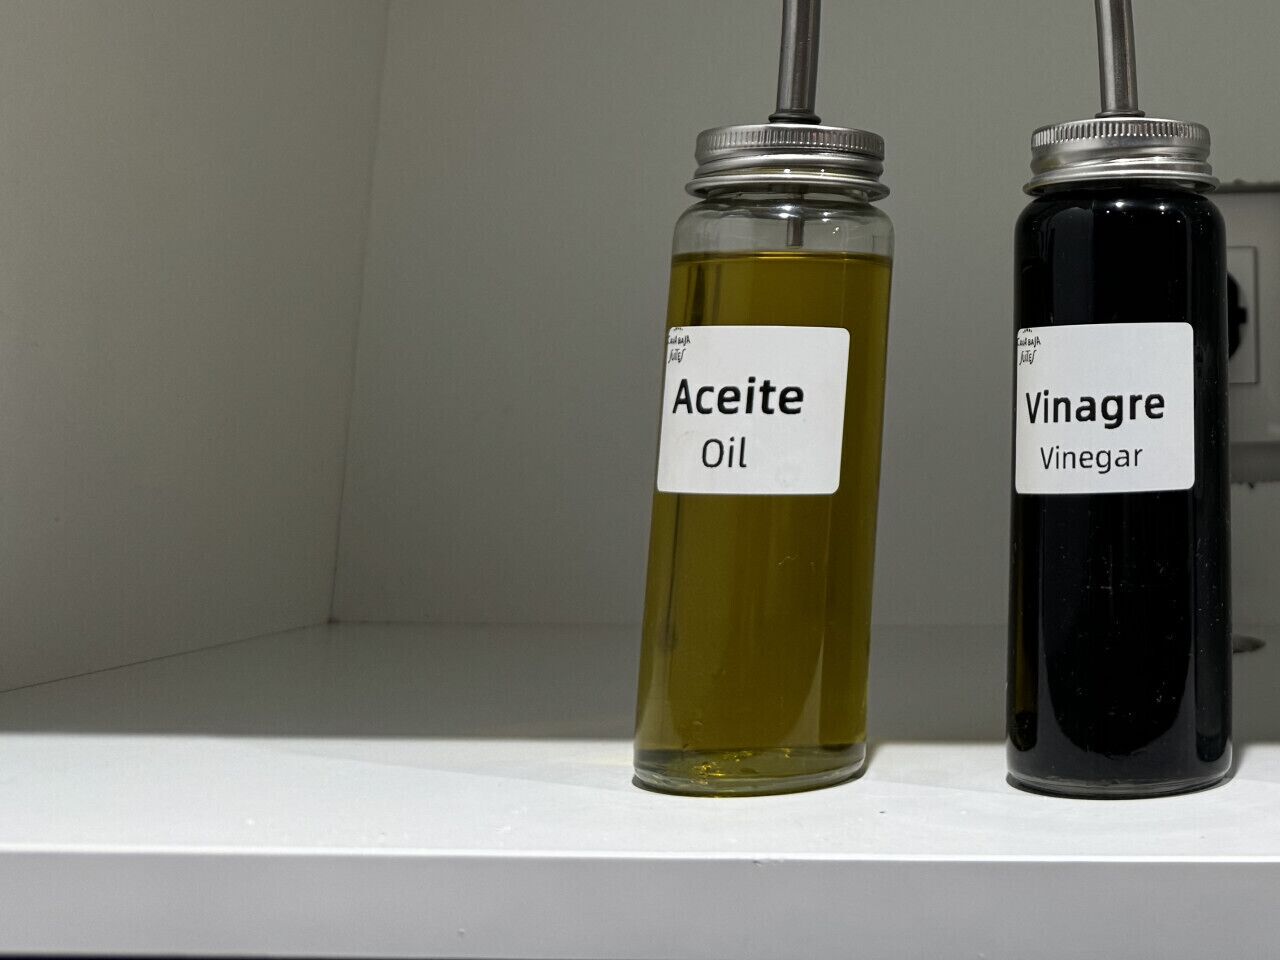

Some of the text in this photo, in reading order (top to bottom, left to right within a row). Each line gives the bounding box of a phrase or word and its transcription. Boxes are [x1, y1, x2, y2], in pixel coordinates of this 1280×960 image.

[672, 376, 804, 415] Aceite
[1025, 389, 1165, 430] Vinagre
[701, 436, 747, 469] Oil
[1040, 445, 1143, 475] Vinegar
